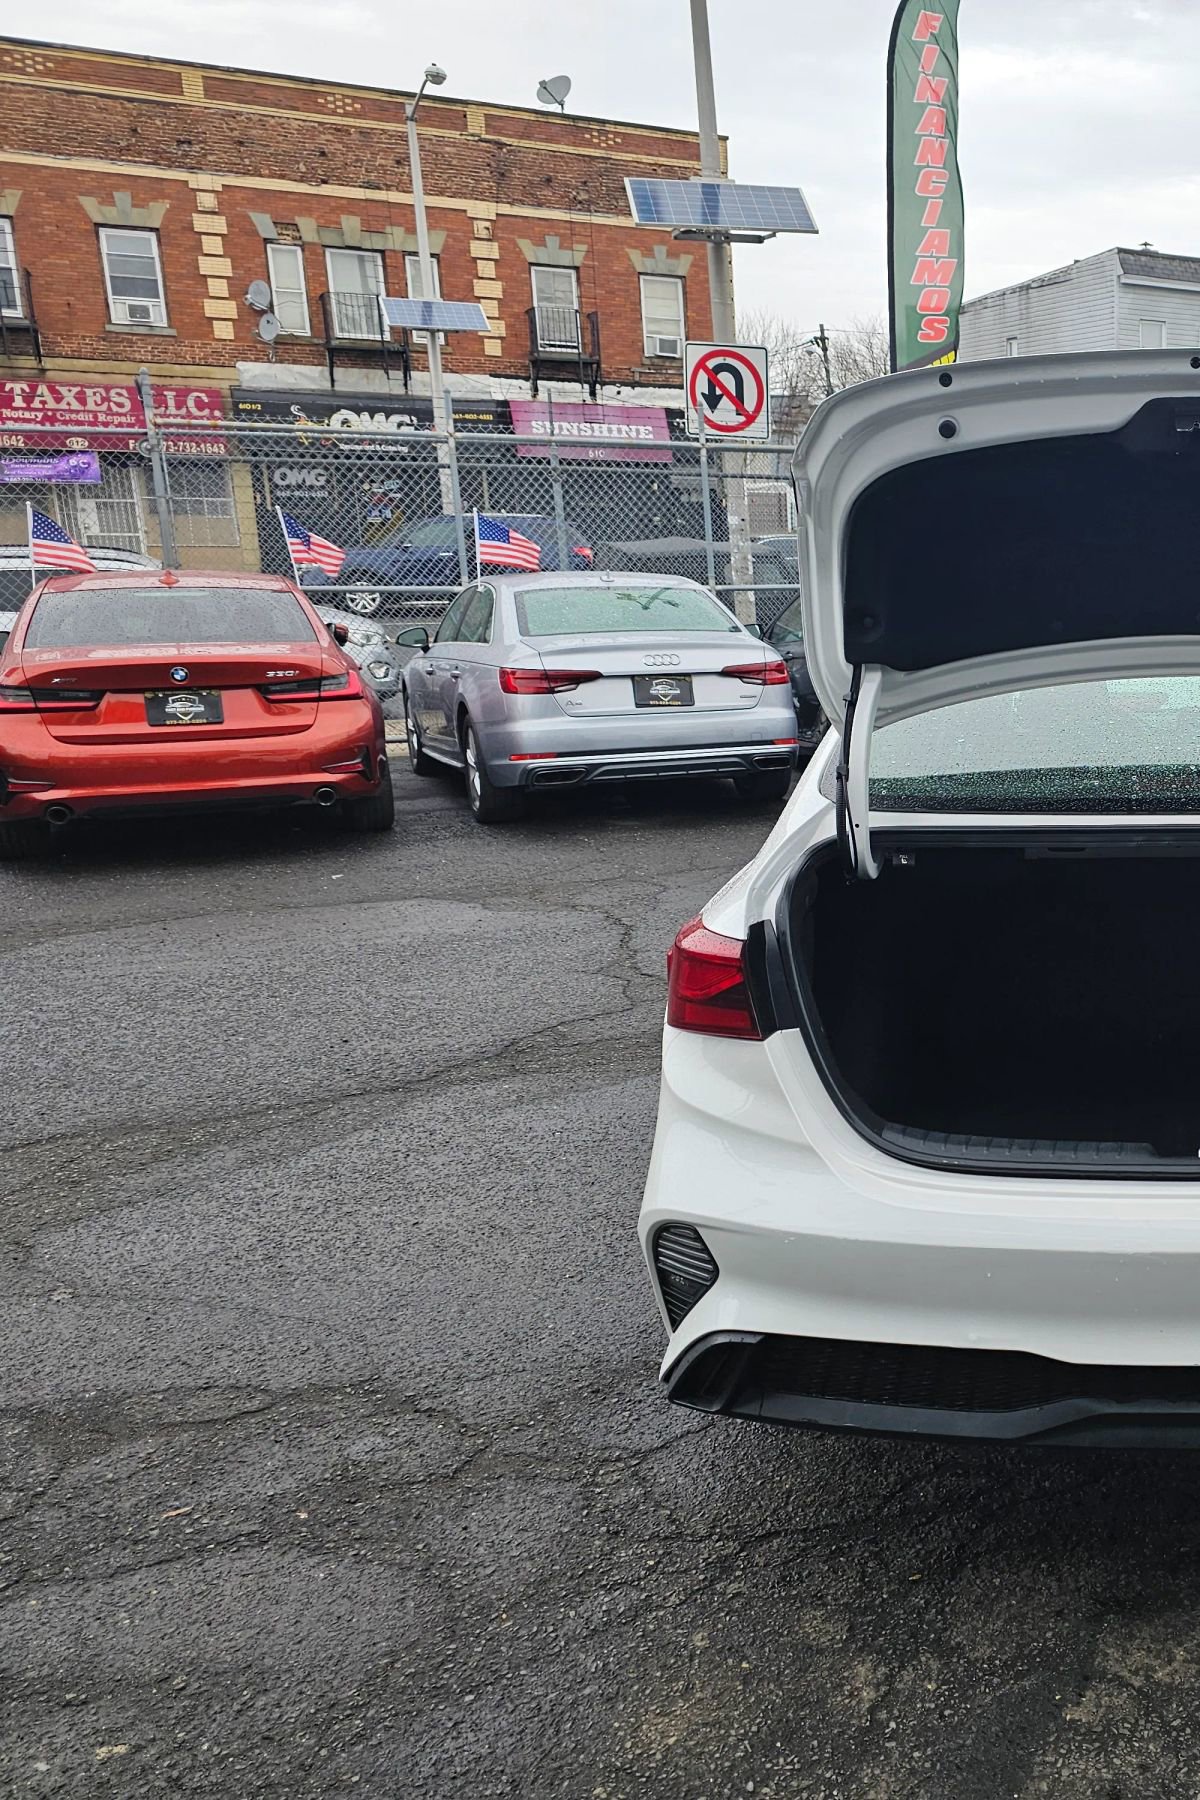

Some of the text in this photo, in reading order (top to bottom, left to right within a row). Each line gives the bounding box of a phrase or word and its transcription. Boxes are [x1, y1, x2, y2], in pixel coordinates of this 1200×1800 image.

[912, 10, 957, 343] FINANCIAMOS
[4, 382, 131, 414] TAXES
[1, 409, 136, 424] Notary Credit Repair
[531, 420, 654, 439] SUNSHINE
[68, 439, 86, 448] 612
[162, 441, 225, 454] 73-732-1643
[588, 449, 605, 458] 610
[274, 467, 327, 485] OMG
